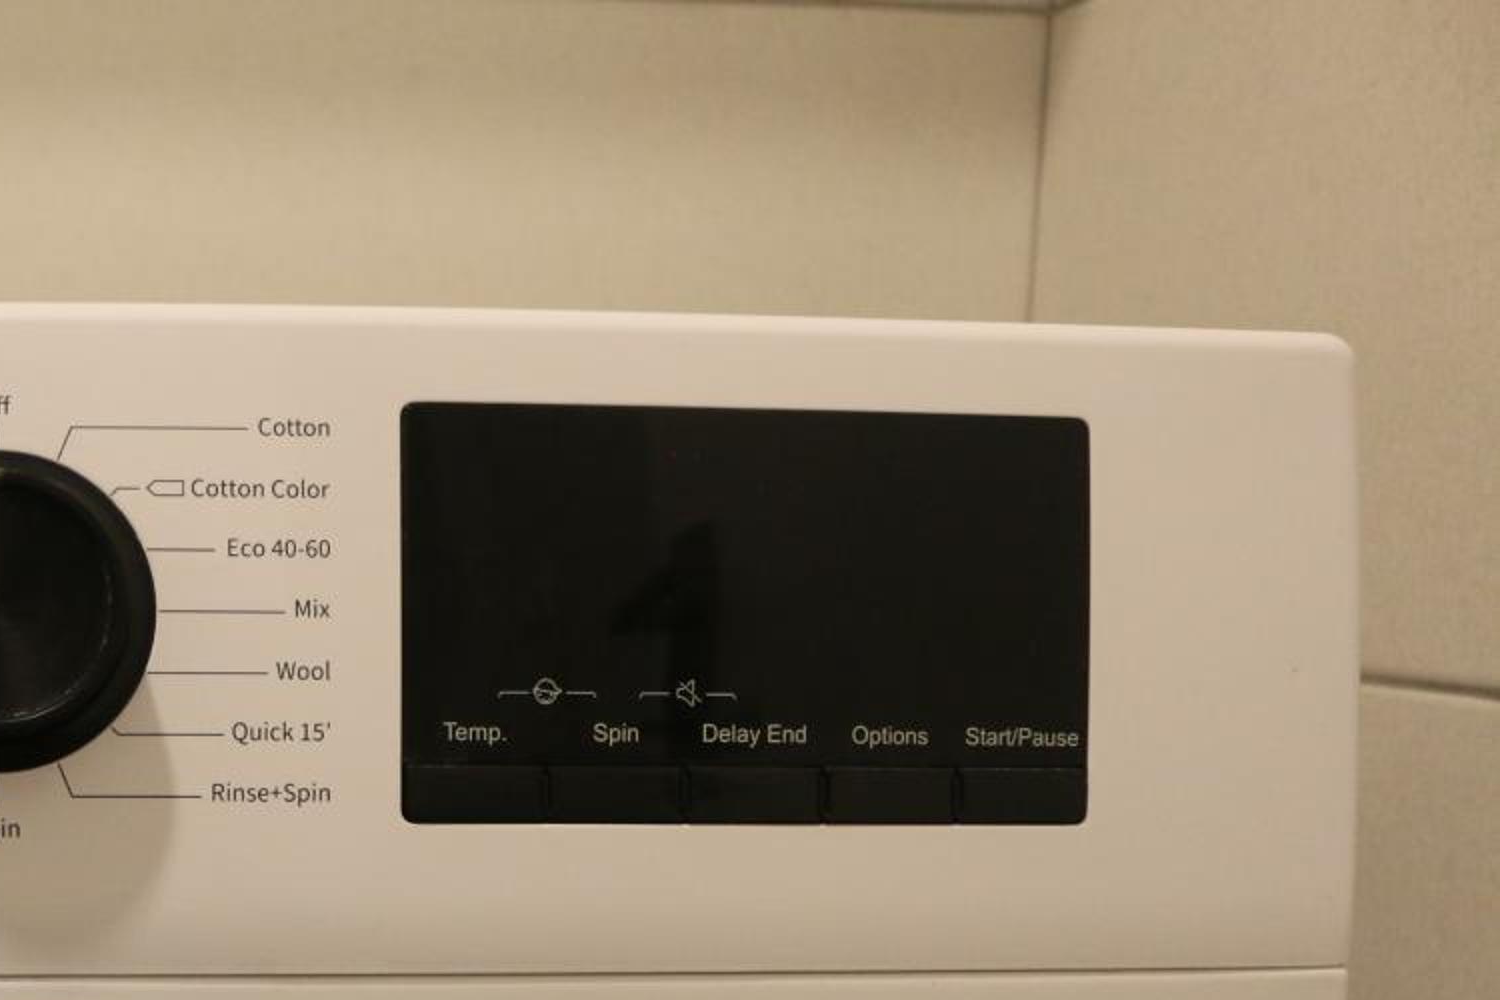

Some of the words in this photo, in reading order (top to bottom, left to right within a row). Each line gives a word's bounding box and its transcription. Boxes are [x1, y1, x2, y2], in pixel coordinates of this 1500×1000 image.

[258, 418, 330, 437] Cotton
[191, 479, 264, 498] Cotton
[271, 480, 330, 499] Color
[228, 538, 265, 558] Eco
[272, 539, 330, 558] 40-60
[295, 599, 329, 618] Mix
[276, 661, 330, 680] Wool
[232, 721, 293, 746] Quick
[301, 722, 330, 742] 15'
[443, 722, 506, 746] Temp.
[593, 723, 639, 746] Spin
[703, 723, 760, 748] Delay
[767, 724, 807, 743] End
[852, 725, 928, 749] Options
[966, 727, 1079, 747] Start/Pause
[212, 783, 330, 807] Rinse+Spin
